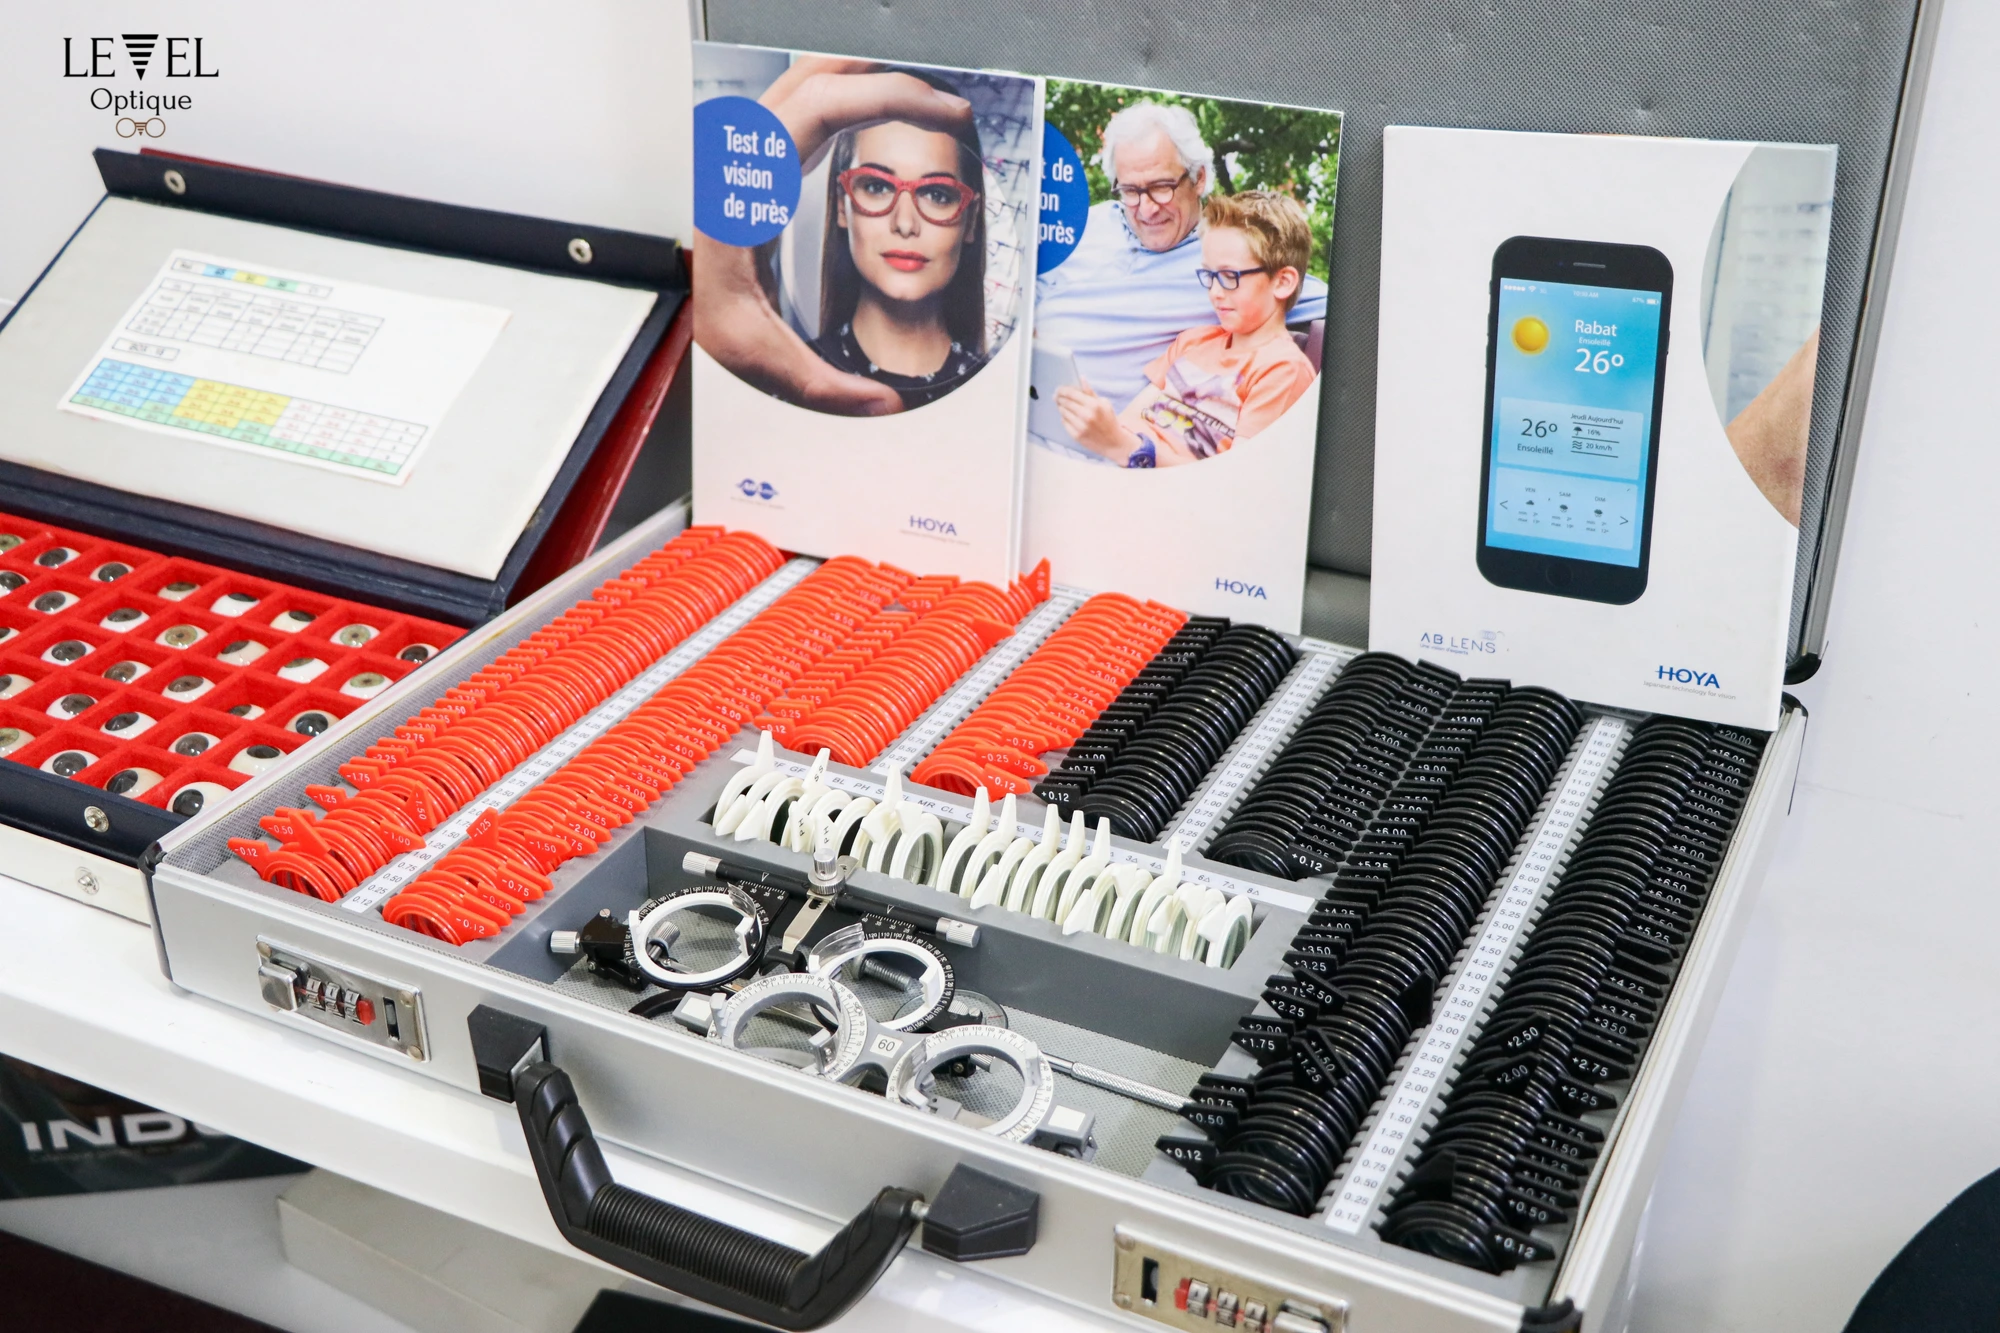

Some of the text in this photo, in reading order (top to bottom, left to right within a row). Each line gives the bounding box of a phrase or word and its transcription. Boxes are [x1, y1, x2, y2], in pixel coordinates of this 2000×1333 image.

[723, 125, 786, 159] Test de
[1052, 157, 1074, 183] de
[723, 162, 772, 191] vision
[723, 193, 789, 227] de près
[1038, 220, 1075, 245] près
[1575, 320, 1618, 337] Rabat
[1578, 337, 1611, 347] Ensoleillé
[1517, 443, 1554, 455] Ensoleillé
[908, 515, 957, 536] HOYA
[1215, 577, 1267, 600] HOYA
[1420, 632, 1496, 654] AB LENS
[1656, 665, 1720, 689] HOYA
[1643, 680, 1671, 690] Japanese
[1672, 685, 1706, 696] technology
[1601, 721, 1621, 729] 20.0
[1598, 731, 1616, 739] 18.0
[1006, 737, 1035, 750] -0.75
[1593, 740, 1611, 748] 16.0
[981, 753, 1009, 763] -0.25
[1239, 751, 1259, 761] 2.25
[1587, 749, 1606, 758] 14.0
[1232, 760, 1252, 769] 2.00
[1582, 759, 1601, 767] 13.0
[1225, 770, 1244, 779] 1.75
[1577, 768, 1596, 777] 12.0
[831, 776, 870, 791] BL PH
[987, 774, 1016, 792] -0.12
[1218, 779, 1237, 789] 1.50
[1571, 778, 1591, 787] 11.0
[313, 793, 337, 804] -1.25
[1041, 790, 1070, 802] +0.12
[1211, 789, 1229, 798] 1.25
[1566, 788, 1586, 797] 10.0
[415, 792, 427, 821] -1.50
[917, 799, 955, 815] MR CL
[1203, 799, 1222, 808] 1.00
[1560, 798, 1580, 808] 9.50
[579, 809, 607, 827] -2.25
[1194, 808, 1214, 818] 0.75
[1554, 808, 1575, 818] 9.00
[472, 818, 492, 839] -1.25
[1186, 818, 1206, 828] 0.50
[1548, 819, 1569, 829] 8.50
[268, 824, 294, 836] -0.50
[441, 829, 461, 839] 1.50
[568, 822, 596, 839] -2.00
[1178, 828, 1199, 838] 0.25
[1542, 829, 1564, 839] 8.00
[383, 829, 411, 846] -1.00
[427, 839, 447, 850] 1.25
[528, 840, 557, 854] -1.50
[1537, 840, 1558, 850] 7.50
[234, 847, 259, 858] -0.12
[413, 850, 432, 861] 1.00
[1531, 851, 1552, 861] 7.00
[397, 861, 418, 872] 0.75
[1292, 853, 1323, 872] +0.12
[1524, 862, 1546, 872] 6.50
[382, 872, 403, 883] 0.50
[1518, 874, 1540, 884] 6.00
[367, 884, 388, 895] 0.25
[501, 877, 530, 897] -0.75
[1512, 885, 1534, 896] 5.75
[352, 895, 373, 907] 0.12
[482, 893, 511, 911] -0.50
[1505, 897, 1528, 907] 5.50
[1499, 908, 1521, 919] 5.25
[455, 916, 486, 935] -0.12
[1492, 920, 1515, 931] 5.00
[1486, 933, 1508, 943] 4.75
[1479, 945, 1502, 956] 4.50
[1472, 958, 1494, 969] 4.25
[1465, 971, 1488, 982] 4.00
[1300, 981, 1333, 1004] +2.50
[1457, 983, 1481, 995] 3.75
[1271, 999, 1305, 1018] +2.25
[1450, 997, 1474, 1008] 3.50
[1442, 1010, 1467, 1022] 3.25
[1435, 1024, 1459, 1036] 3.00
[1507, 1026, 1540, 1048] +2.50
[876, 1040, 896, 1054] 60
[1240, 1038, 1275, 1050] +1.75
[1427, 1038, 1452, 1050] 2.75
[1310, 1040, 1336, 1072] +1.50
[1419, 1052, 1444, 1064] 2.50
[1296, 1051, 1323, 1083] +1.25
[1572, 1056, 1609, 1077] +2.75
[1412, 1067, 1437, 1079] 2.25
[1496, 1064, 1529, 1083] +2.00
[1404, 1081, 1428, 1094] 2.00
[1561, 1085, 1598, 1107] +2.25
[1397, 1096, 1421, 1109] 1.75
[1188, 1112, 1224, 1125] +0.50
[1389, 1112, 1412, 1125] 1.50
[21, 1111, 228, 1151] IND
[1380, 1127, 1404, 1140] 1.25
[1372, 1143, 1395, 1156] 1.00
[1540, 1136, 1579, 1157] +1.50
[1166, 1147, 1202, 1161] +0.12
[1361, 1159, 1387, 1172] 0.75
[1353, 1175, 1378, 1189] 0.50
[1343, 1192, 1369, 1206] 0.25
[1334, 1208, 1360, 1223] 0.12
[1508, 1198, 1548, 1222] +0.50
[1494, 1233, 1535, 1259] +0.12
